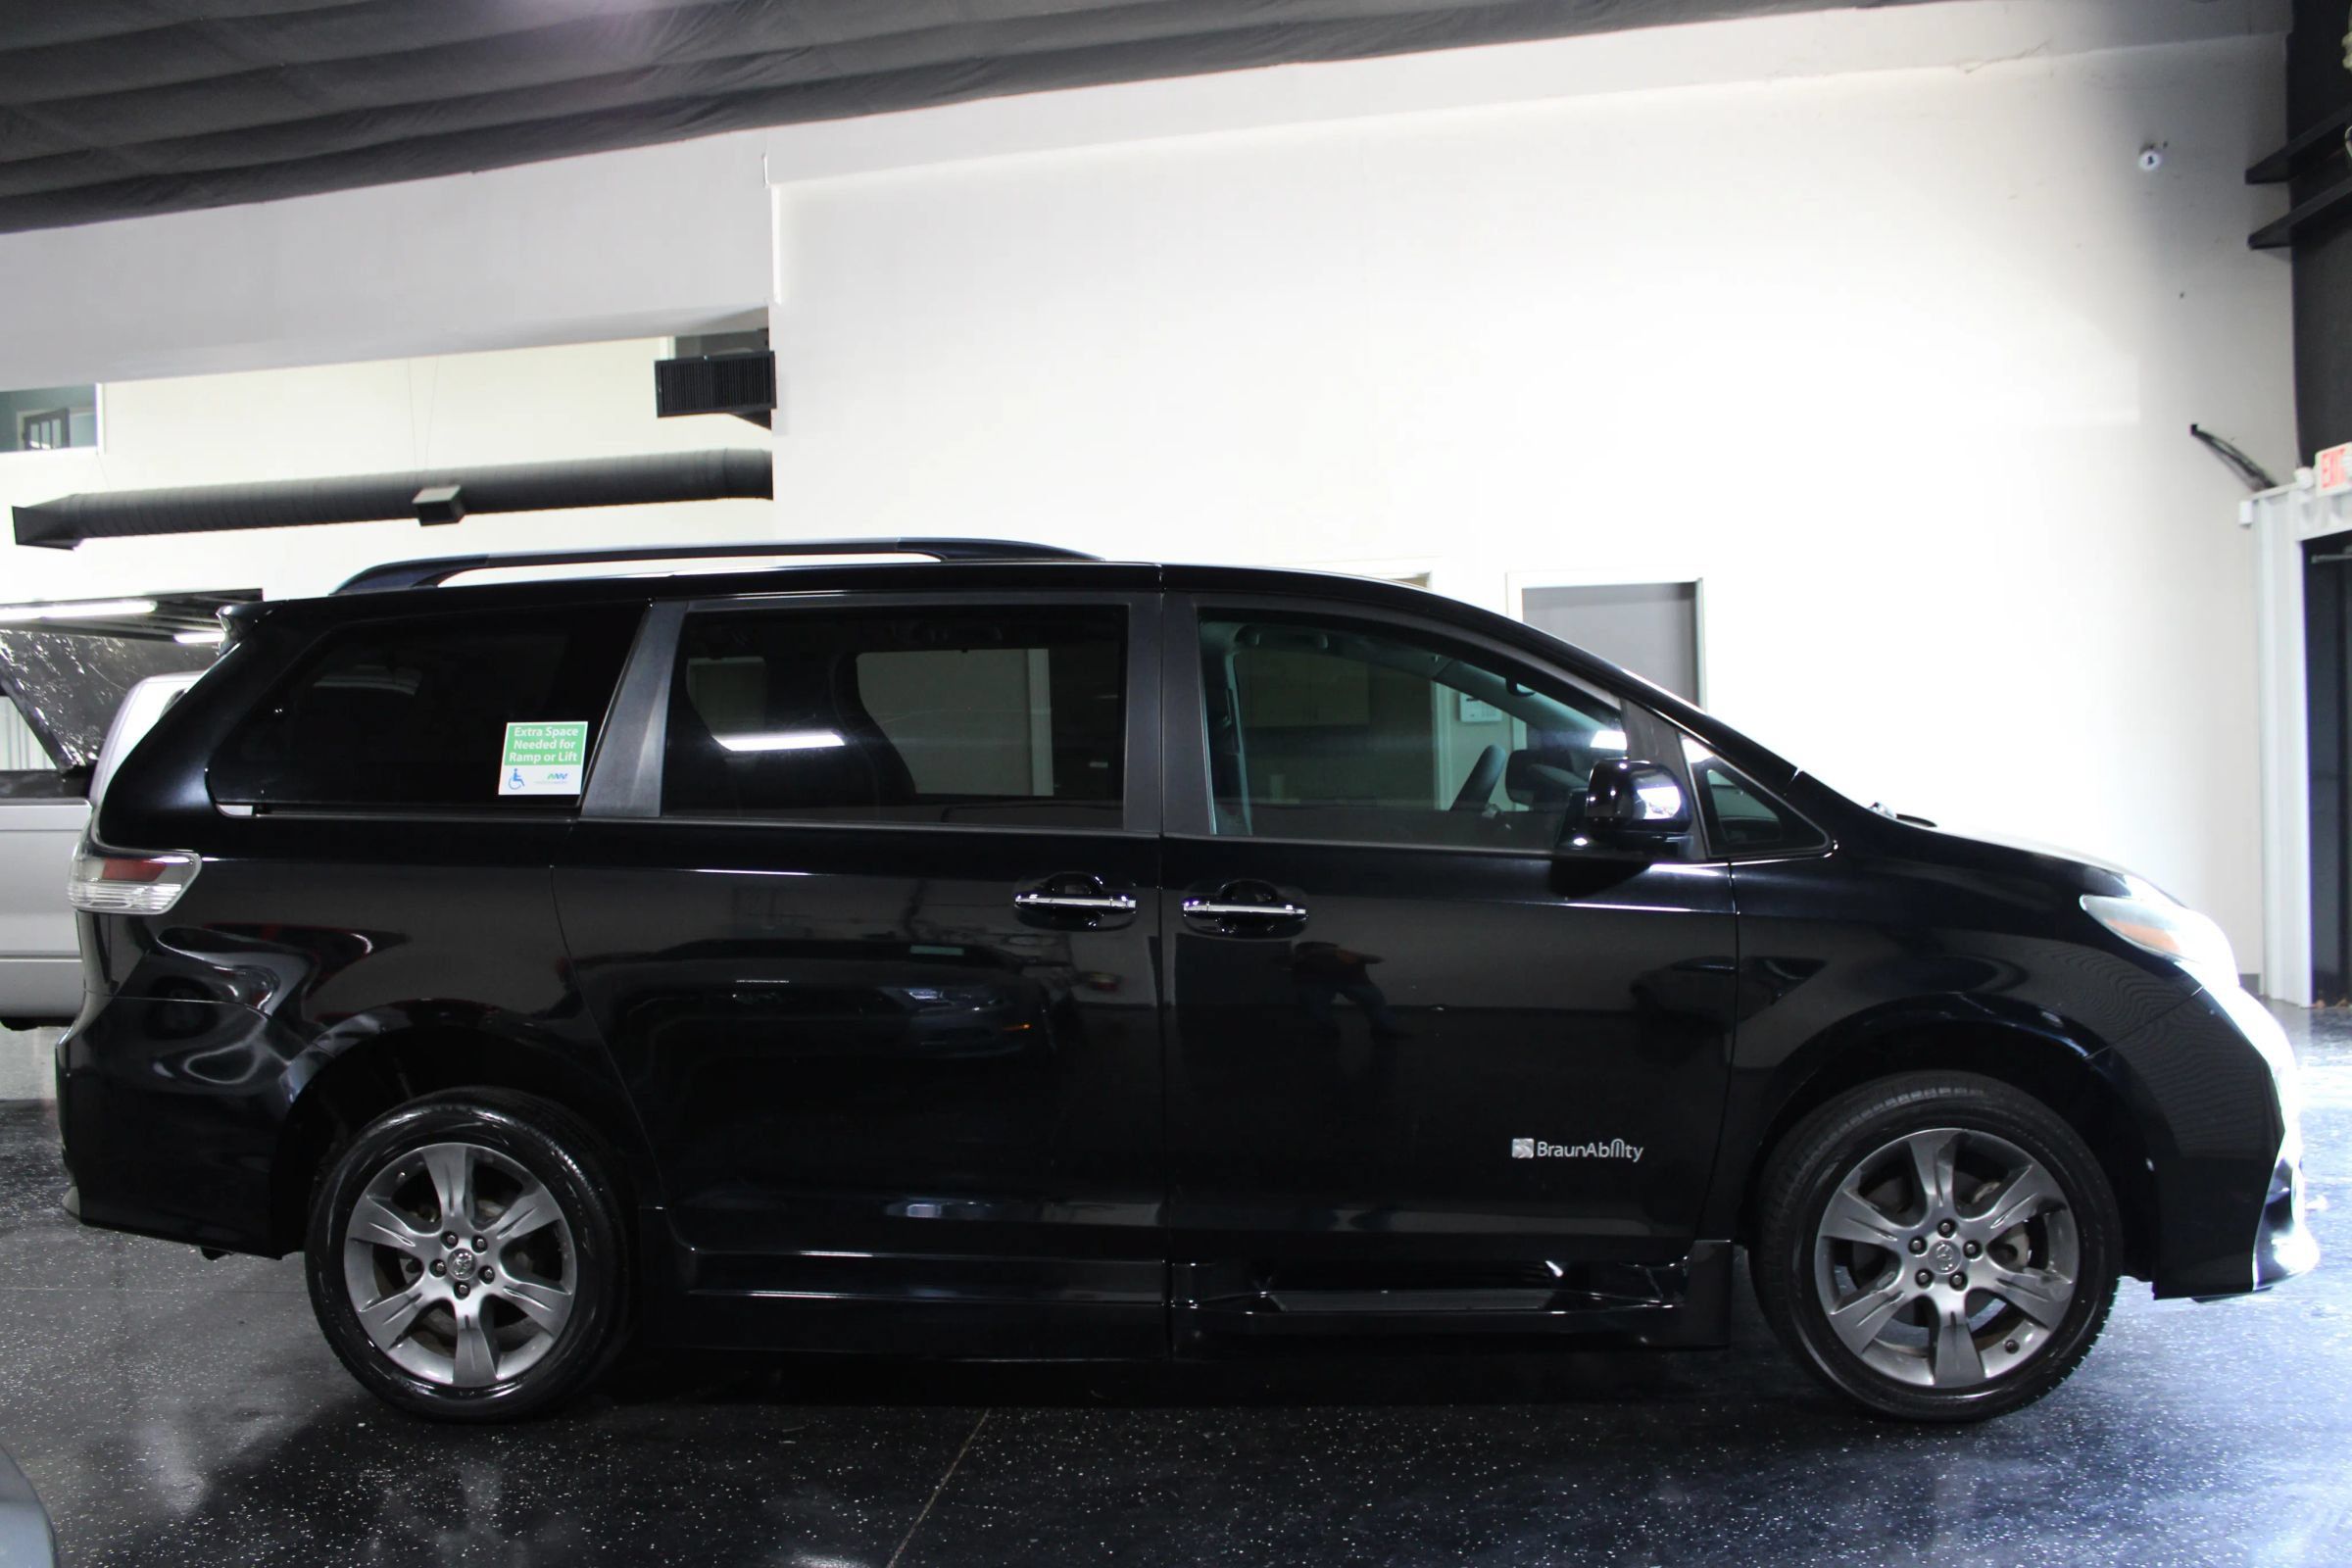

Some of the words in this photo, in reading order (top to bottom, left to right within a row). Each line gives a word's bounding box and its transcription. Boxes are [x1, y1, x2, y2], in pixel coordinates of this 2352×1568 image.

[514, 726, 543, 737] Extra
[545, 726, 579, 738] Space
[514, 739, 558, 750] Needed
[559, 739, 576, 750] for
[509, 752, 541, 764] Ramp
[543, 754, 556, 762] or
[558, 752, 578, 762] Lift
[1537, 1138, 1644, 1163] BraunAbility
